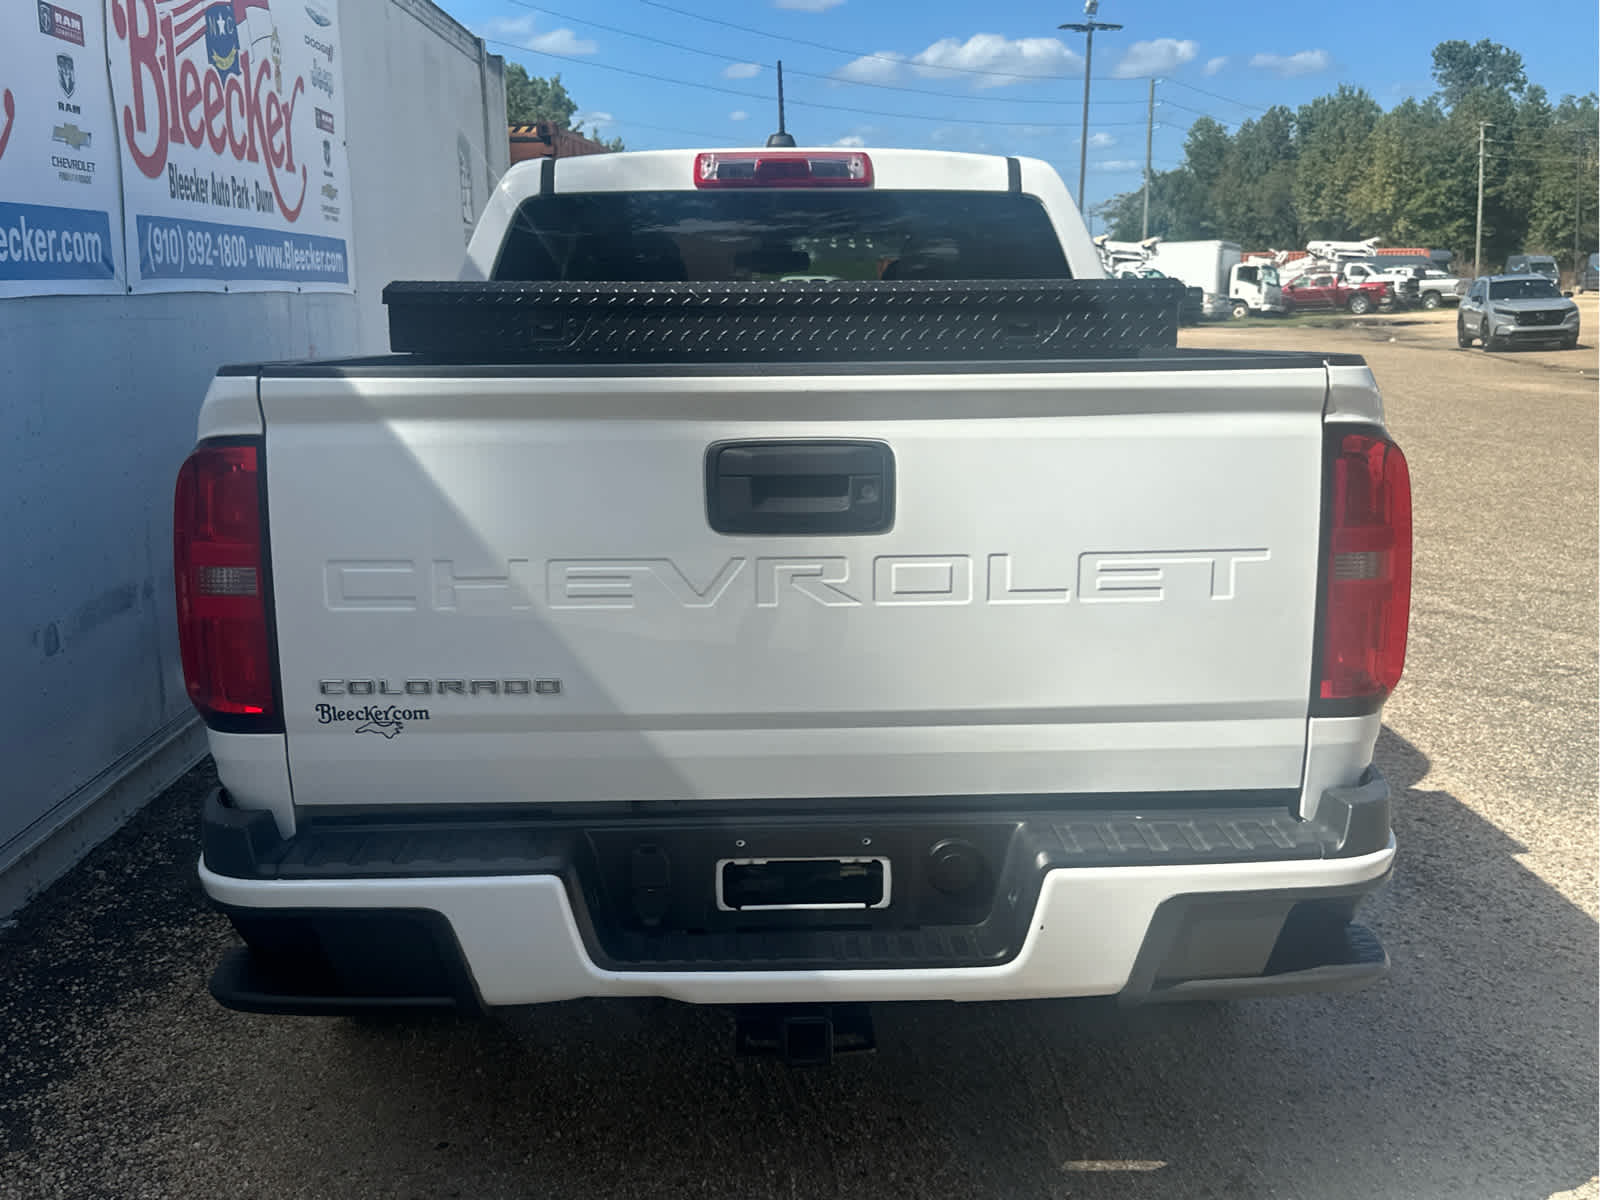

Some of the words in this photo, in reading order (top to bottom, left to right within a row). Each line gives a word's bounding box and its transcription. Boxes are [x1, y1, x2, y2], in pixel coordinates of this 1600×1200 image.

[57, 101, 81, 115] RAM
[51, 155, 95, 173] CHEVROLET
[168, 162, 209, 201] Bleecker
[211, 171, 231, 208] Auto
[231, 175, 250, 211] Park
[255, 180, 275, 214] Dunn
[147, 223, 185, 273] (910)
[186, 231, 248, 268] 892-1800
[255, 241, 345, 274] www.Bleecker.com
[322, 547, 1272, 613] CHEVROLET
[319, 678, 563, 696] COLORADO
